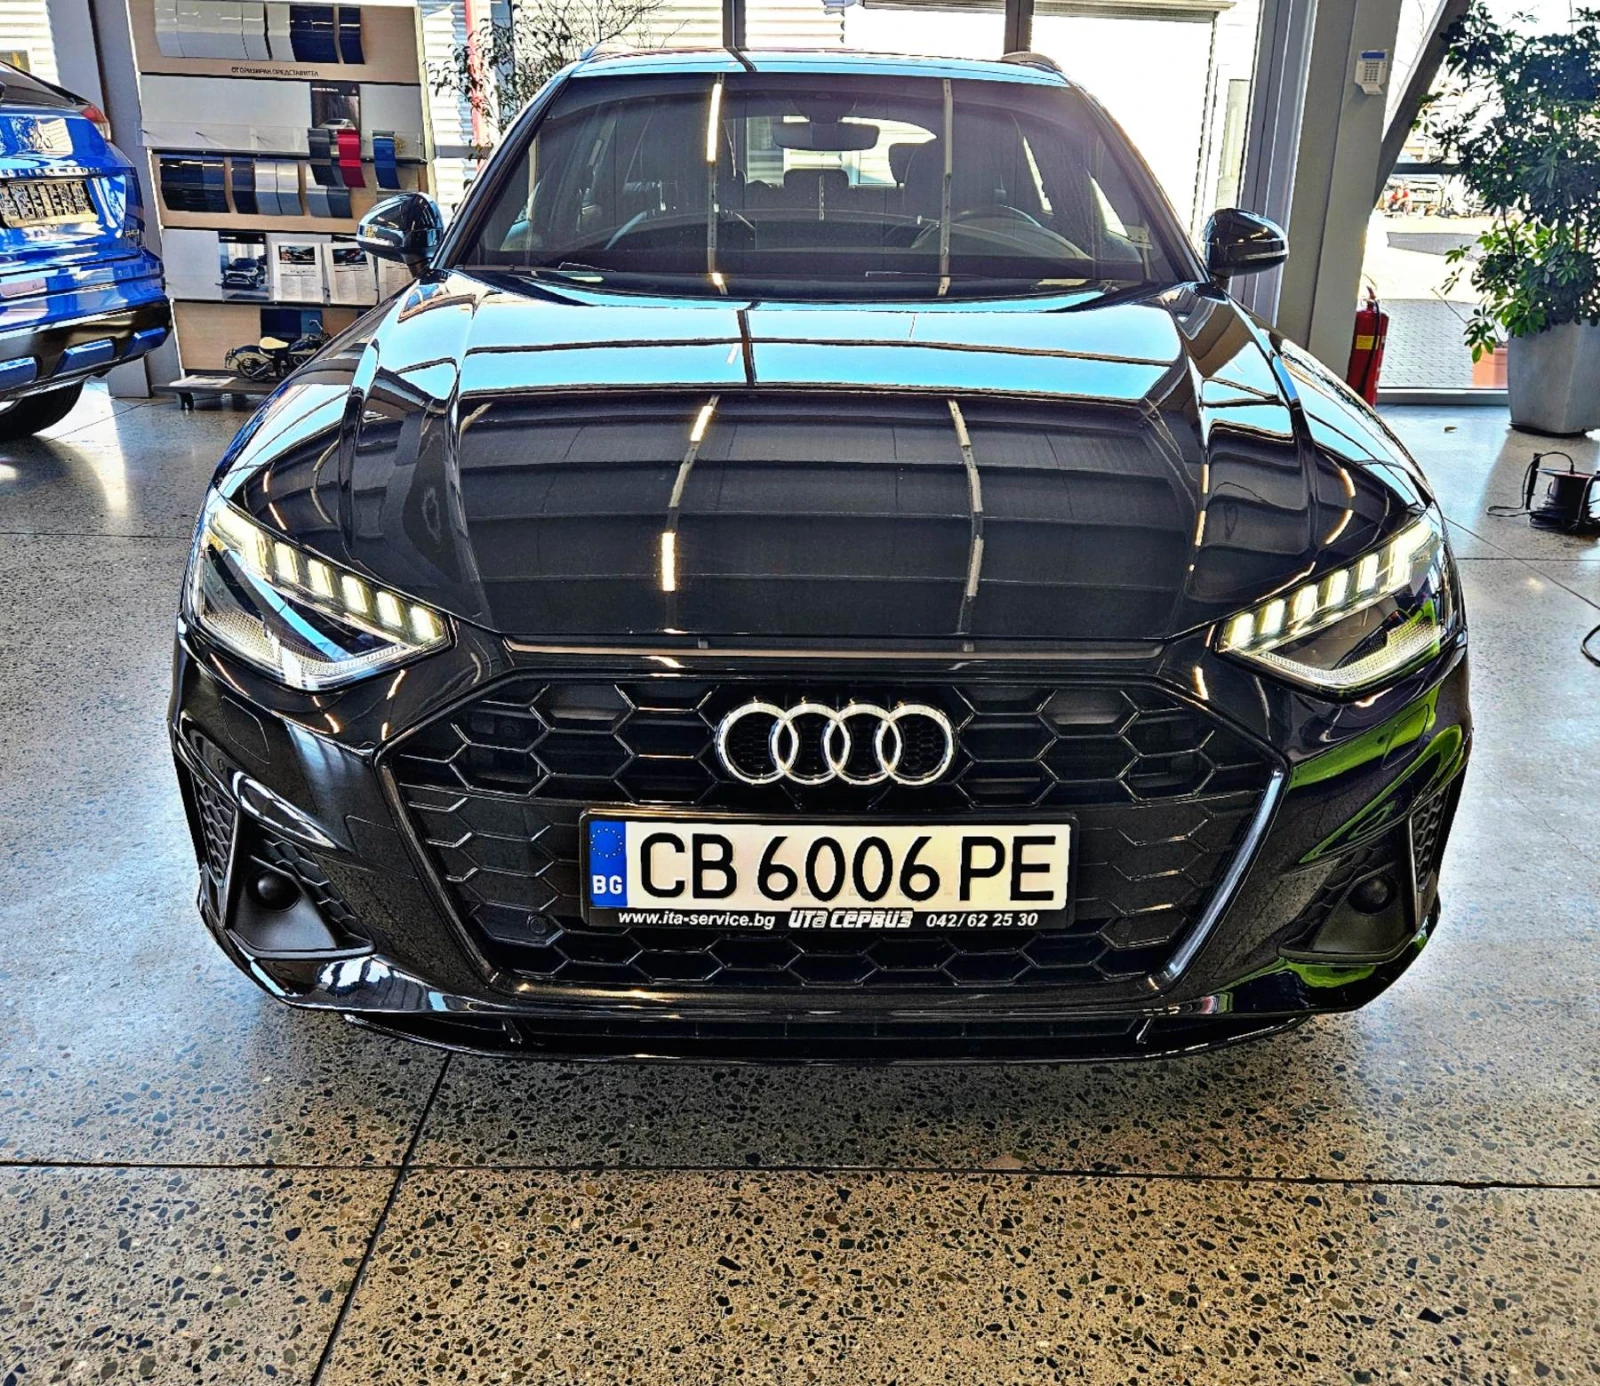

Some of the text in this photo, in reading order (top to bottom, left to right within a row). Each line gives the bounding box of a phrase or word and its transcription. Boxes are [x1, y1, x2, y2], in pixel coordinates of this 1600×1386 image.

[640, 832, 1056, 902] CB 6006 PE
[592, 875, 623, 895] BG
[618, 911, 776, 930] www.ita-service.bg
[992, 912, 1014, 927] 25
[1017, 912, 1039, 927] 30
